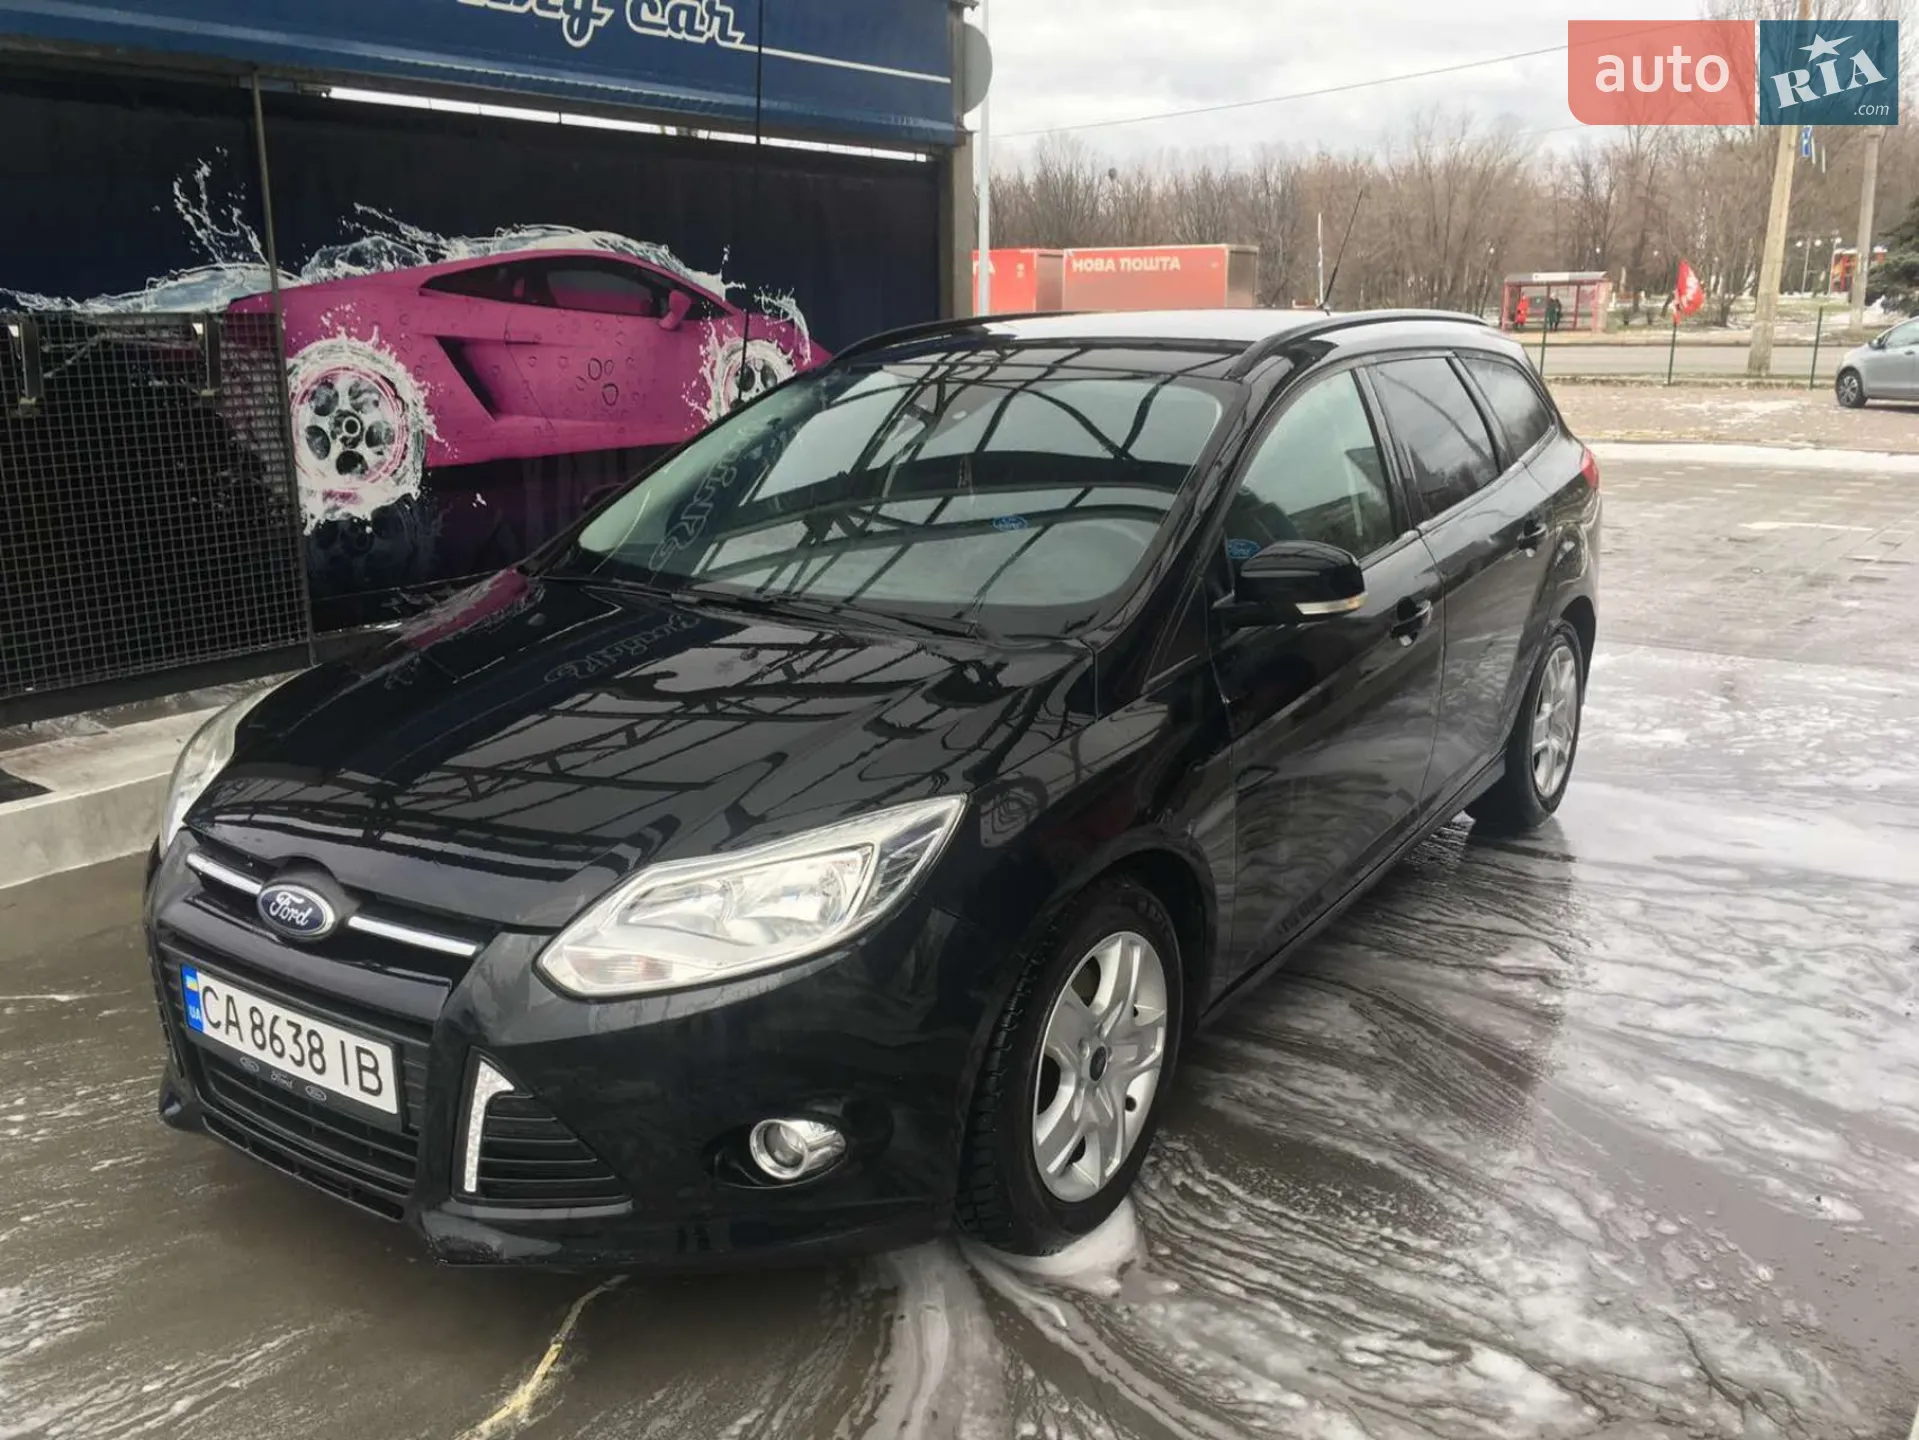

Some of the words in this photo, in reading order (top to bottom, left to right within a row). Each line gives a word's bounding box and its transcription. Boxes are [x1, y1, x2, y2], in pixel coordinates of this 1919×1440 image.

[1072, 256, 1116, 273] НОВА
[1120, 255, 1181, 271] ПОШТА
[269, 891, 313, 927] Ford
[249, 1006, 327, 1076] 8638
